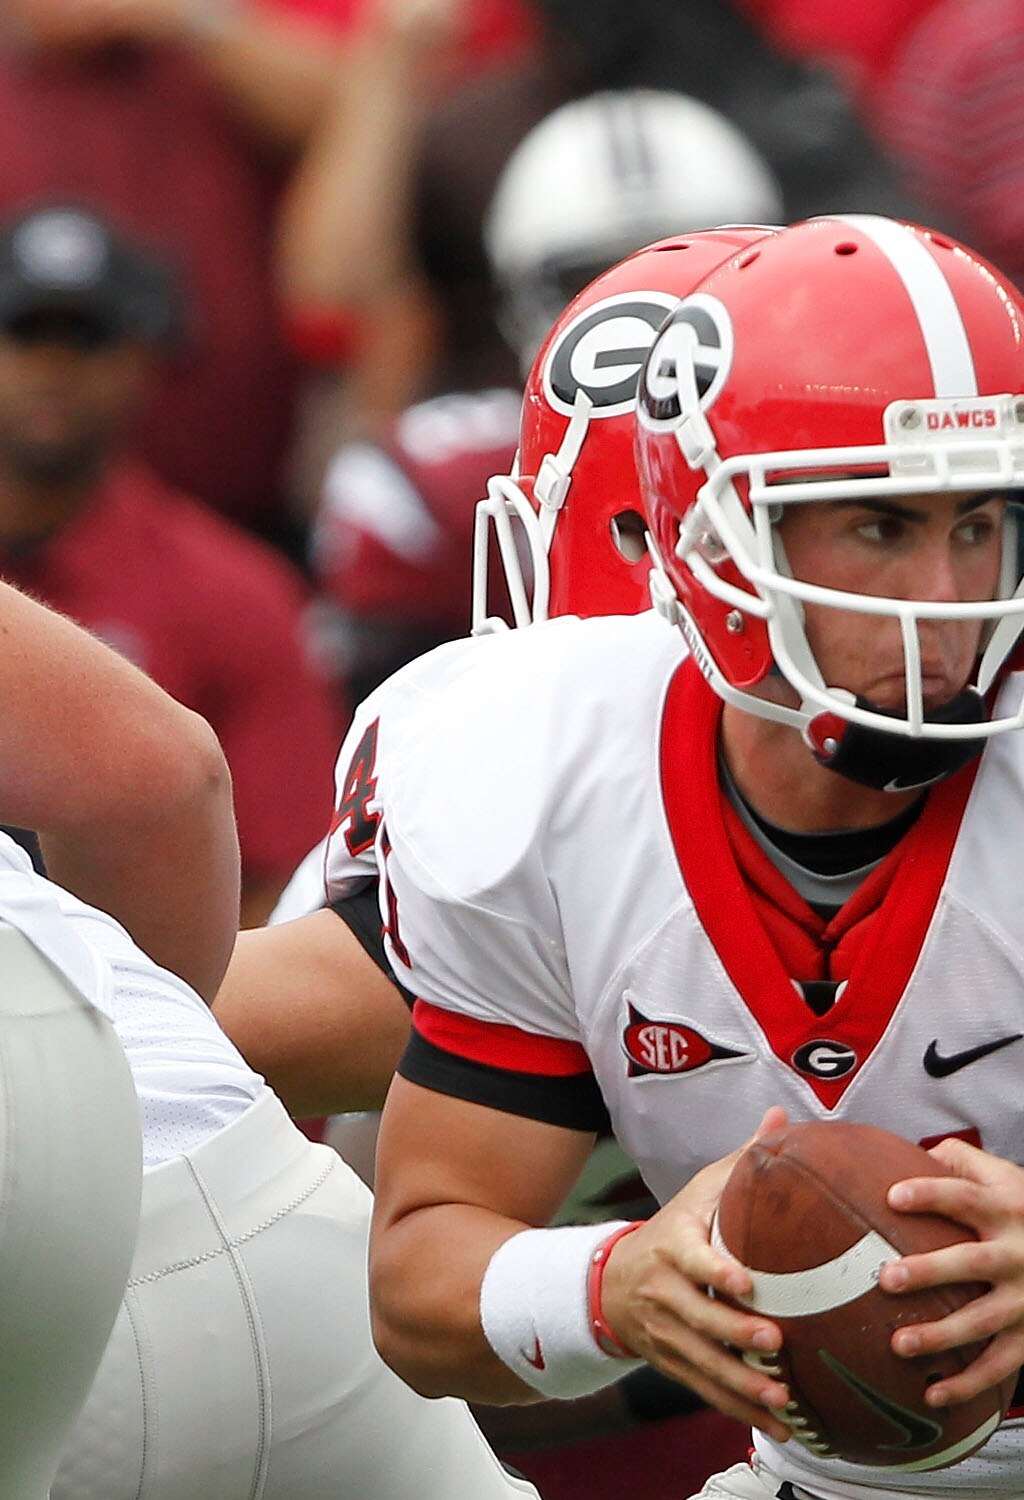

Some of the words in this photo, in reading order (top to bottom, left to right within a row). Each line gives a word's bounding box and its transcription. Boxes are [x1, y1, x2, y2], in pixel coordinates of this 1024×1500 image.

[926, 409, 997, 430] DAWGS
[637, 1025, 689, 1070] SEC
[793, 1039, 857, 1078] G
